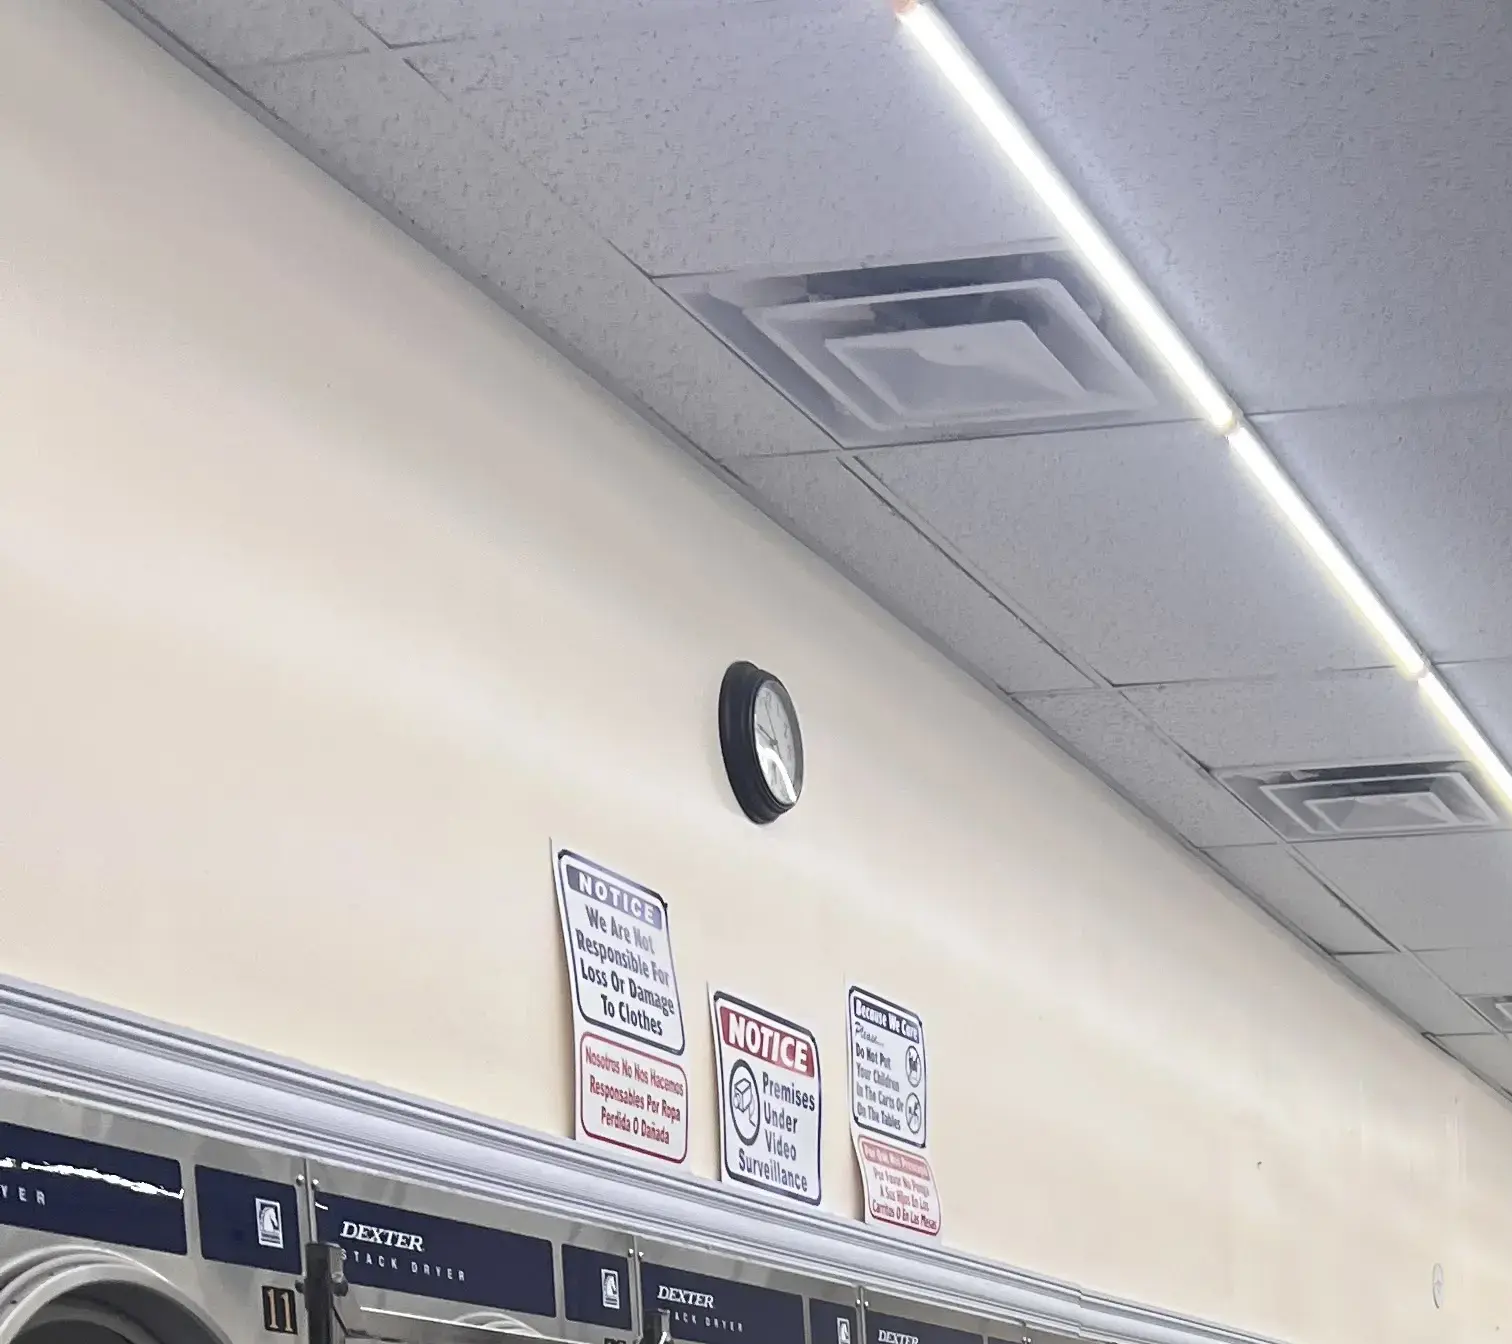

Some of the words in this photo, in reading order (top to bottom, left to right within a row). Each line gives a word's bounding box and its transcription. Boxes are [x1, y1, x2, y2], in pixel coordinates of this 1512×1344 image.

[578, 871, 655, 924] NOTICE
[585, 903, 607, 933] We
[610, 916, 631, 944] Are
[632, 926, 655, 955] Not
[575, 928, 650, 978] Responsible
[651, 960, 670, 987] For
[580, 957, 608, 988] Loss
[610, 970, 625, 994] Or
[628, 977, 675, 1017] Damage
[600, 993, 615, 1018] To
[618, 1001, 663, 1036] Clothes
[855, 999, 887, 1027] Because
[888, 1012, 900, 1033] We
[901, 1019, 919, 1041] Care
[728, 1011, 809, 1073] NOTICE
[855, 1042, 865, 1059] Do
[866, 1046, 878, 1064] Not
[585, 1046, 621, 1073] Nosotros
[621, 1057, 633, 1078] No
[634, 1063, 649, 1084] Nos
[650, 1067, 684, 1097] Hacemos
[762, 1071, 815, 1112] Premises
[856, 1062, 872, 1081] Your
[873, 1069, 900, 1093] Children
[589, 1074, 645, 1110] Responsables
[646, 1094, 660, 1114] Por
[661, 1099, 681, 1124] Ropa
[865, 1085, 877, 1103] The
[600, 1106, 631, 1132] Perdida
[633, 1117, 639, 1134] O
[641, 1120, 670, 1145] Dañada
[763, 1102, 798, 1133] Under
[880, 1110, 902, 1131] Tables
[764, 1128, 797, 1161] Video
[738, 1147, 808, 1193] Surveillance
[340, 1221, 424, 1252] DEXTER
[340, 1248, 399, 1271] STACK
[411, 1261, 467, 1283] DRYER
[266, 1287, 294, 1333] 11
[657, 1285, 715, 1308] DEXTER
